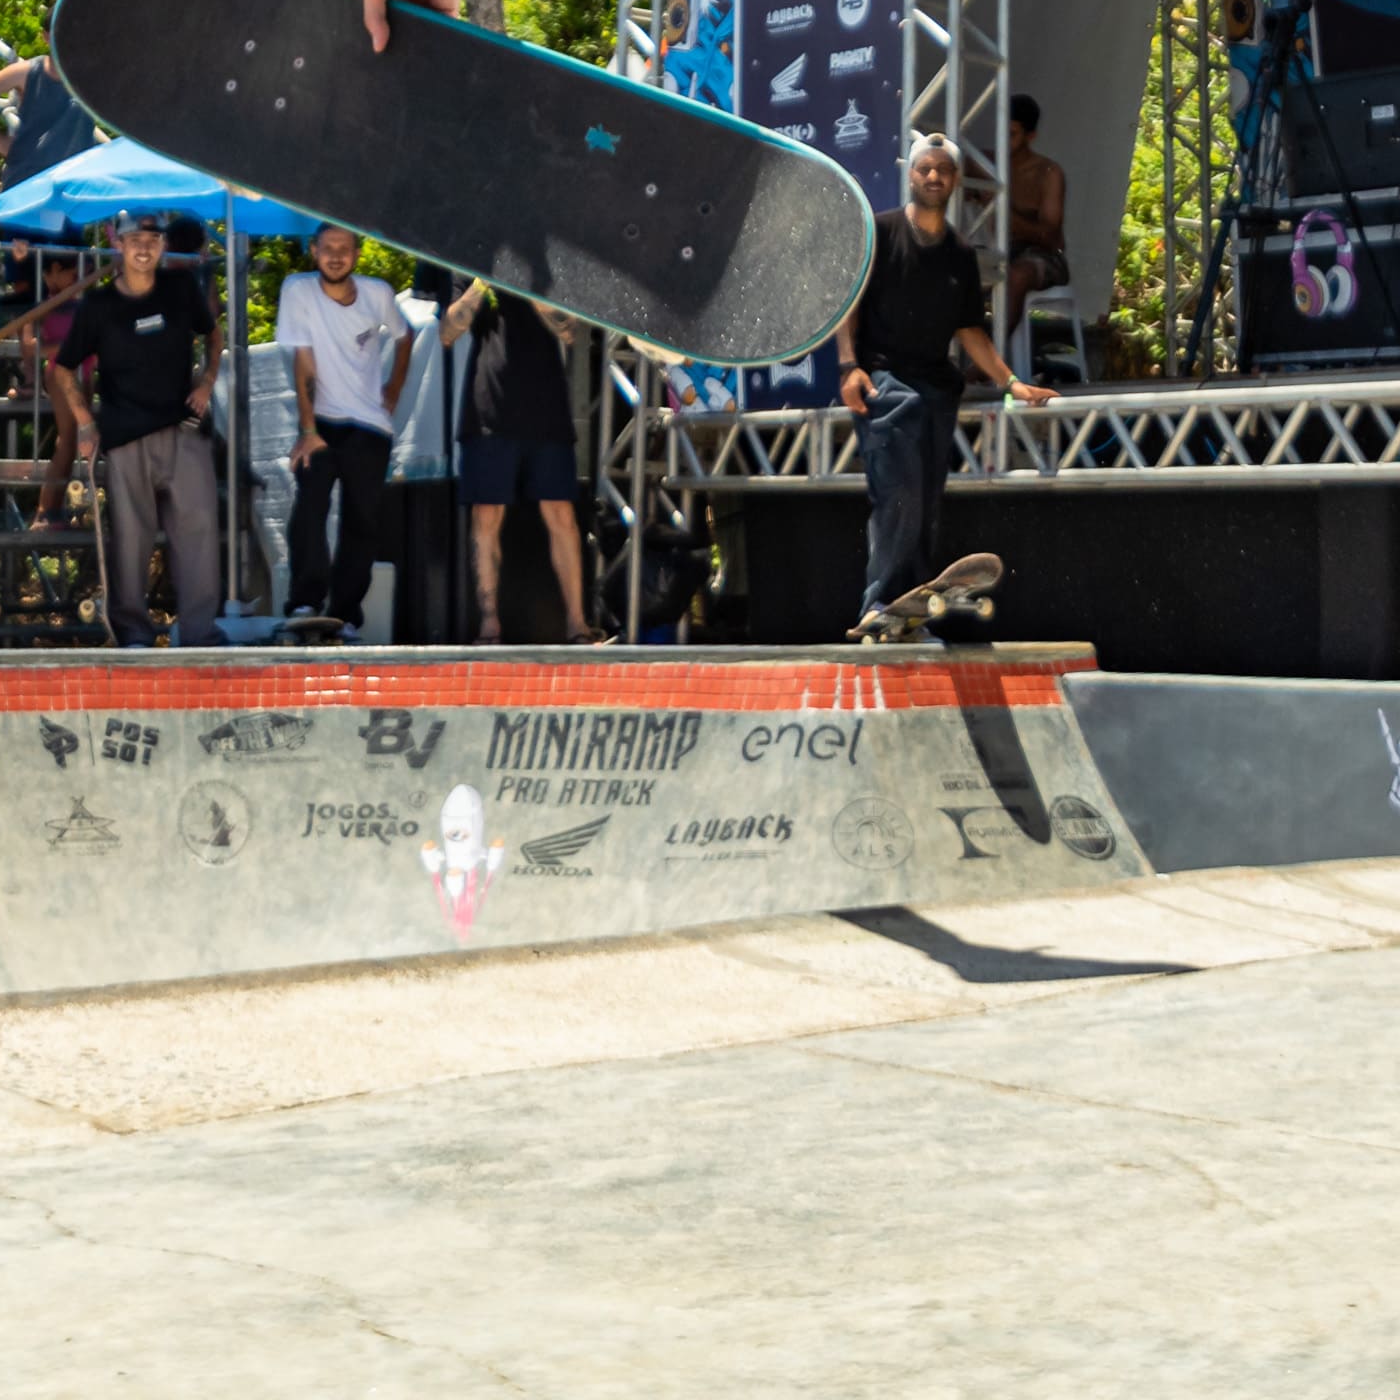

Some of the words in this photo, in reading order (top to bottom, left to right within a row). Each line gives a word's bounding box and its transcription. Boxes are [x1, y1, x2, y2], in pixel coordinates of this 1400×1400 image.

[104, 717, 161, 746] POS
[742, 718, 864, 766] enel
[496, 775, 550, 804] PRO
[558, 778, 658, 806] ATTACK
[301, 803, 390, 838] JOGOS
[664, 813, 794, 846] LAYBACK
[511, 864, 595, 879] HONDA
